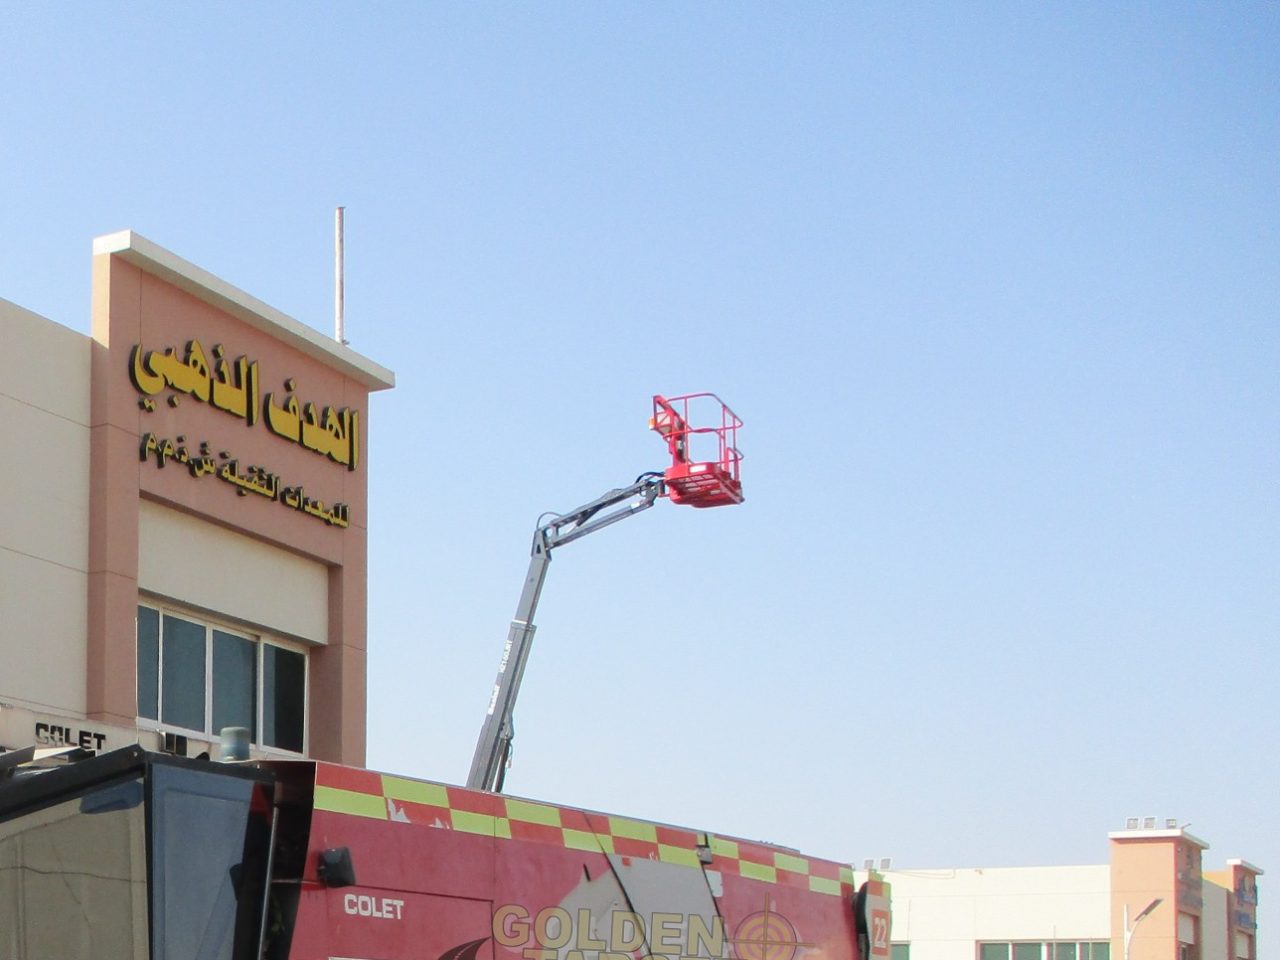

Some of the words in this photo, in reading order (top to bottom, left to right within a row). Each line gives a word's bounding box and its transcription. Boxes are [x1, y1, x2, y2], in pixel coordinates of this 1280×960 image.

[128, 339, 260, 427] الذهبي
[263, 377, 360, 471] الهدف
[35, 722, 106, 750] COLET
[344, 893, 405, 920] COLET
[874, 916, 888, 948] 22
